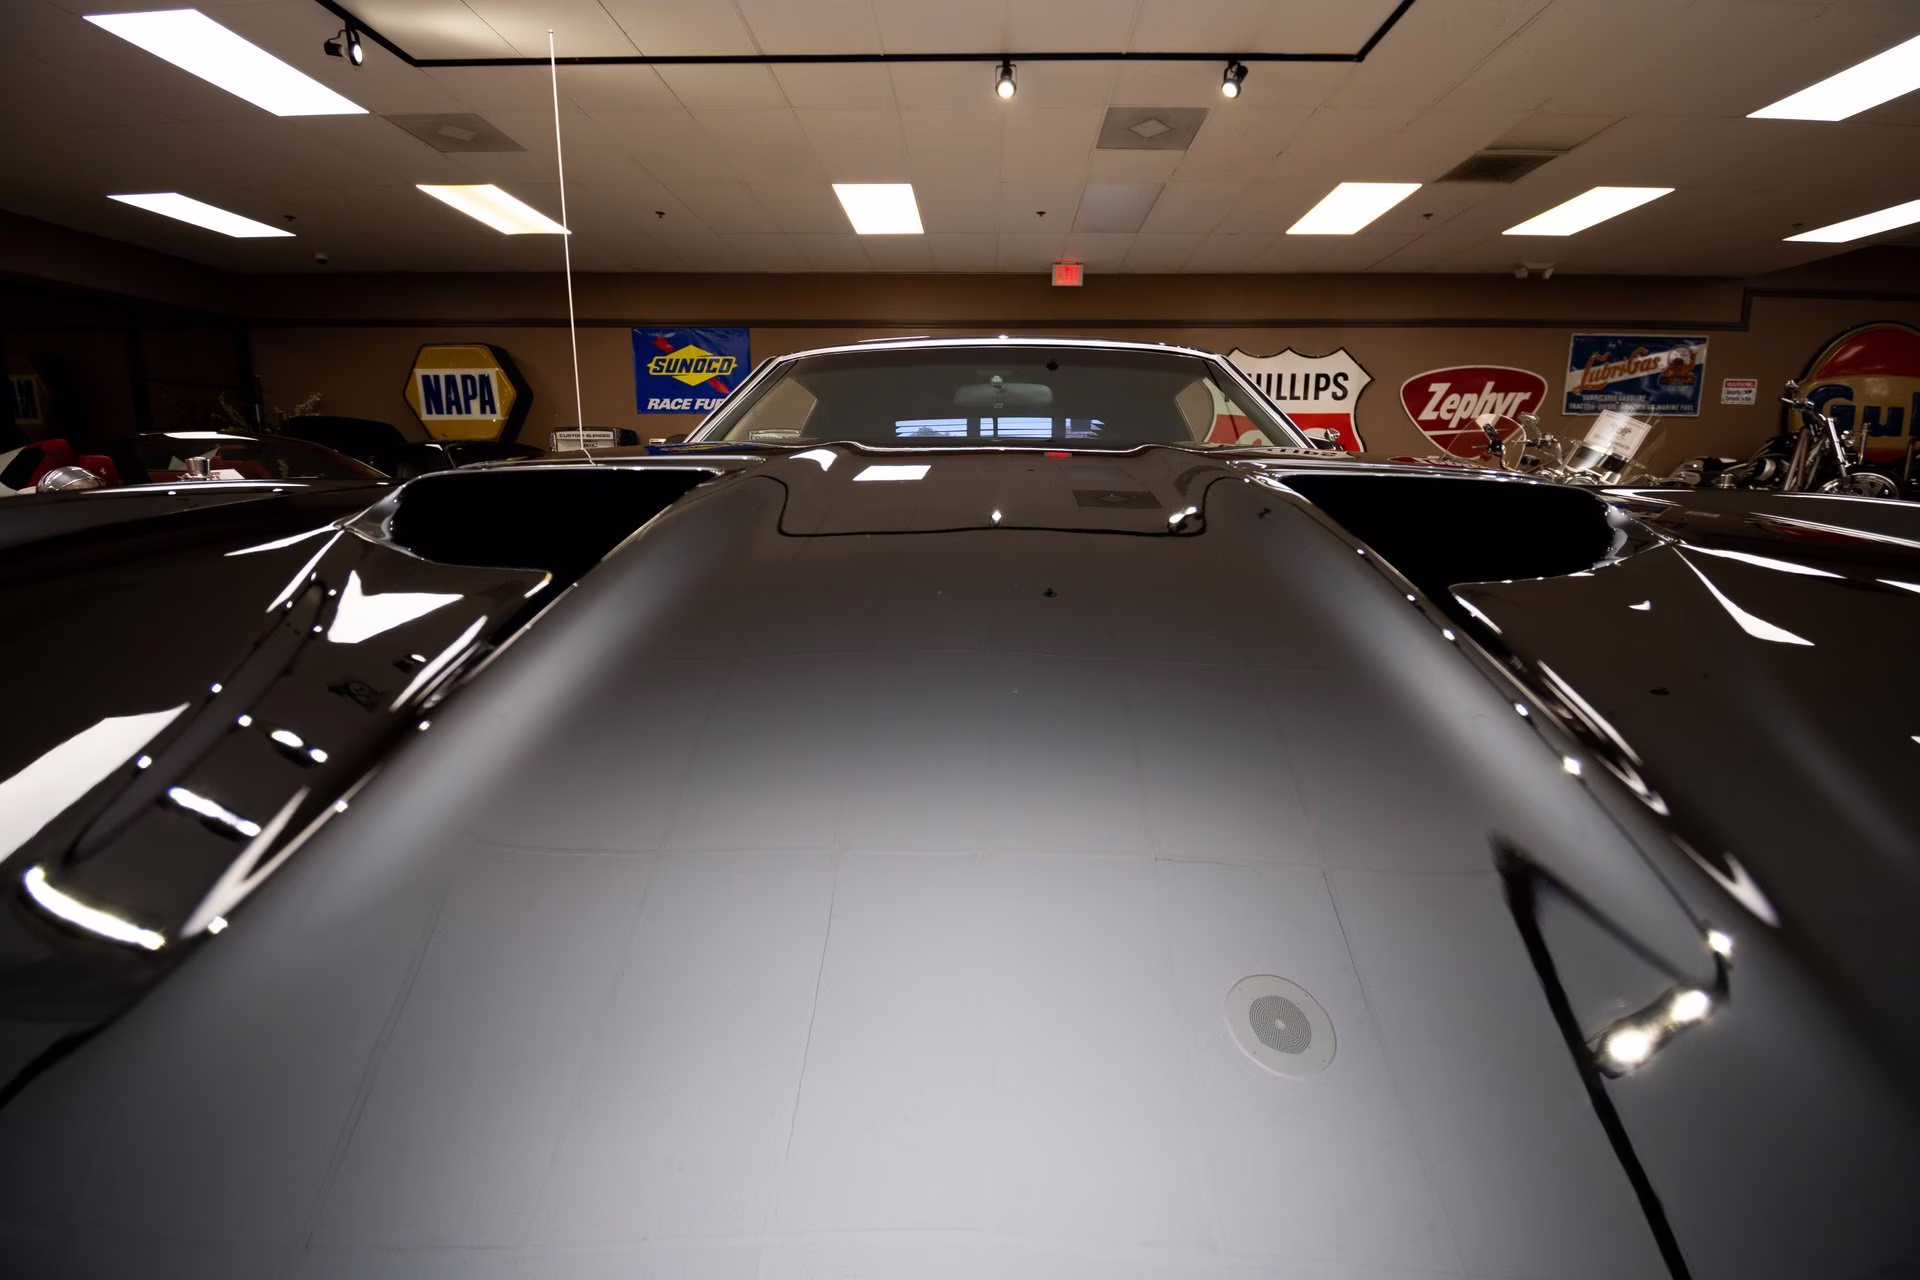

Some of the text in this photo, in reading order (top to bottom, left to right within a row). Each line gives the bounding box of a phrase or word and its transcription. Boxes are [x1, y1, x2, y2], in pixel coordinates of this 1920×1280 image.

[651, 358, 734, 374] SUNOCO
[421, 374, 497, 416] NAPA
[647, 398, 726, 410] RACE FUE
[1247, 372, 1349, 401] ILLIPS
[1418, 381, 1532, 429] Zephyr
[1802, 384, 1920, 437] Gul
